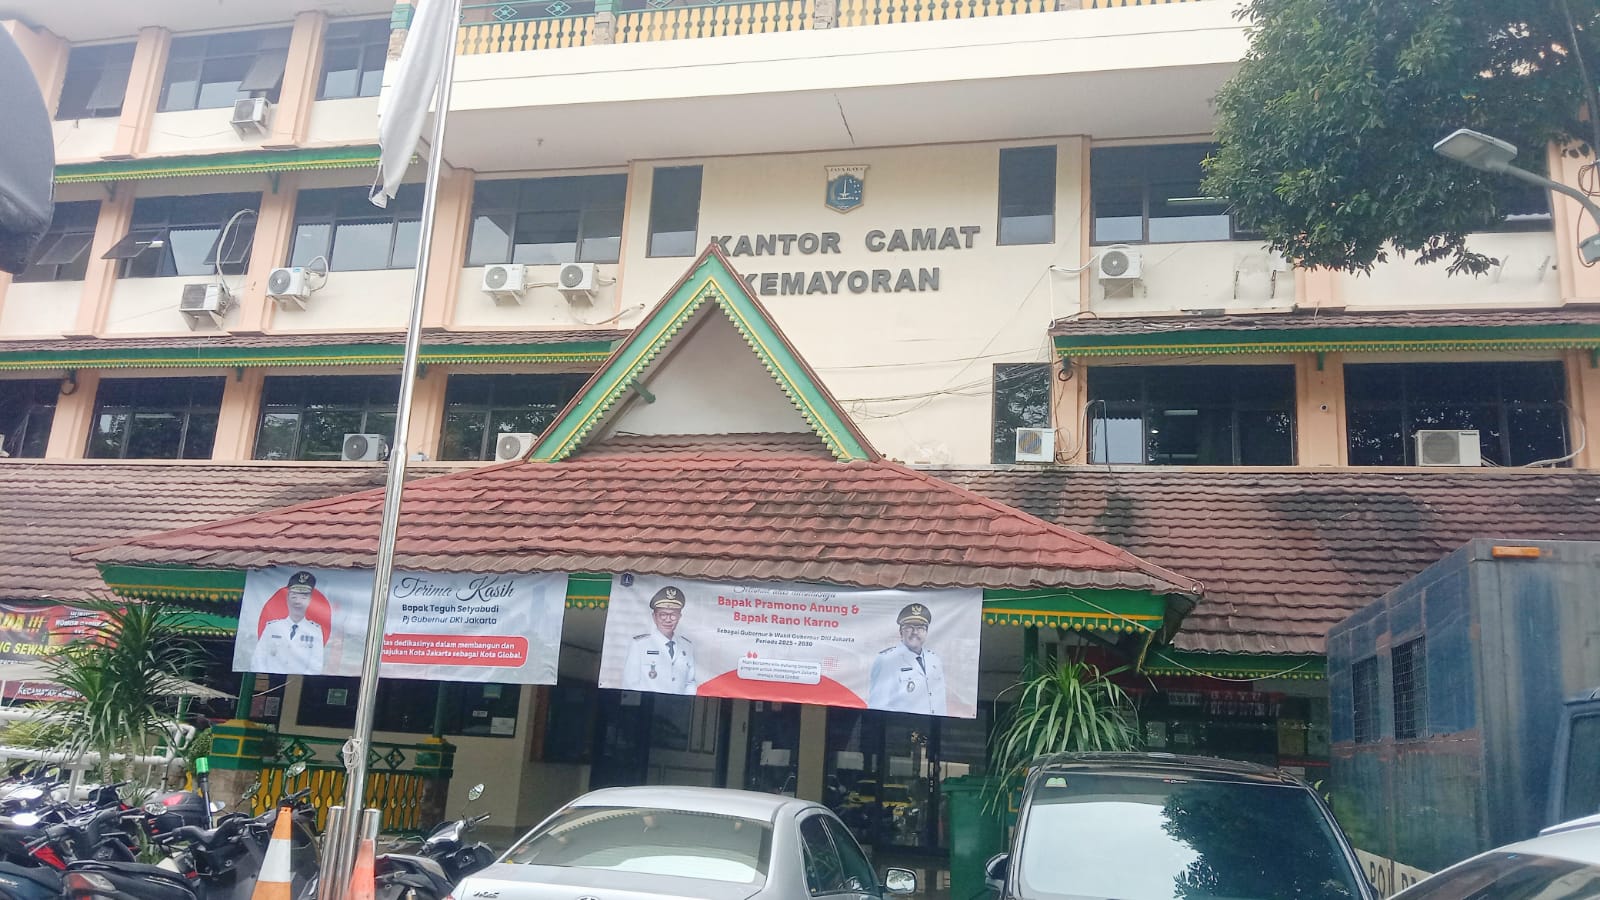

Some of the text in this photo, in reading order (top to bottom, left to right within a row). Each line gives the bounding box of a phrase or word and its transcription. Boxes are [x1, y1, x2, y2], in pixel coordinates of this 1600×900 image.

[710, 225, 980, 256] KANTOR CAMAT
[739, 267, 940, 296] KEMAYORAN
[393, 576, 516, 602] Terima Kasih
[402, 604, 499, 614] Bapak Teguh Setyabudi
[718, 596, 860, 616] Bapak Pramono Anung &
[402, 615, 410, 624] Pj
[411, 615, 448, 624] Gubernur
[464, 616, 497, 624] Jakarta
[733, 611, 839, 628] Bapak Rano Karno
[717, 627, 740, 636] Sebagai
[393, 640, 435, 648] dedikasinya
[458, 641, 500, 650] membangun
[756, 637, 778, 645] Periode
[426, 649, 452, 657] Jakarta
[452, 651, 479, 659] sebagai
